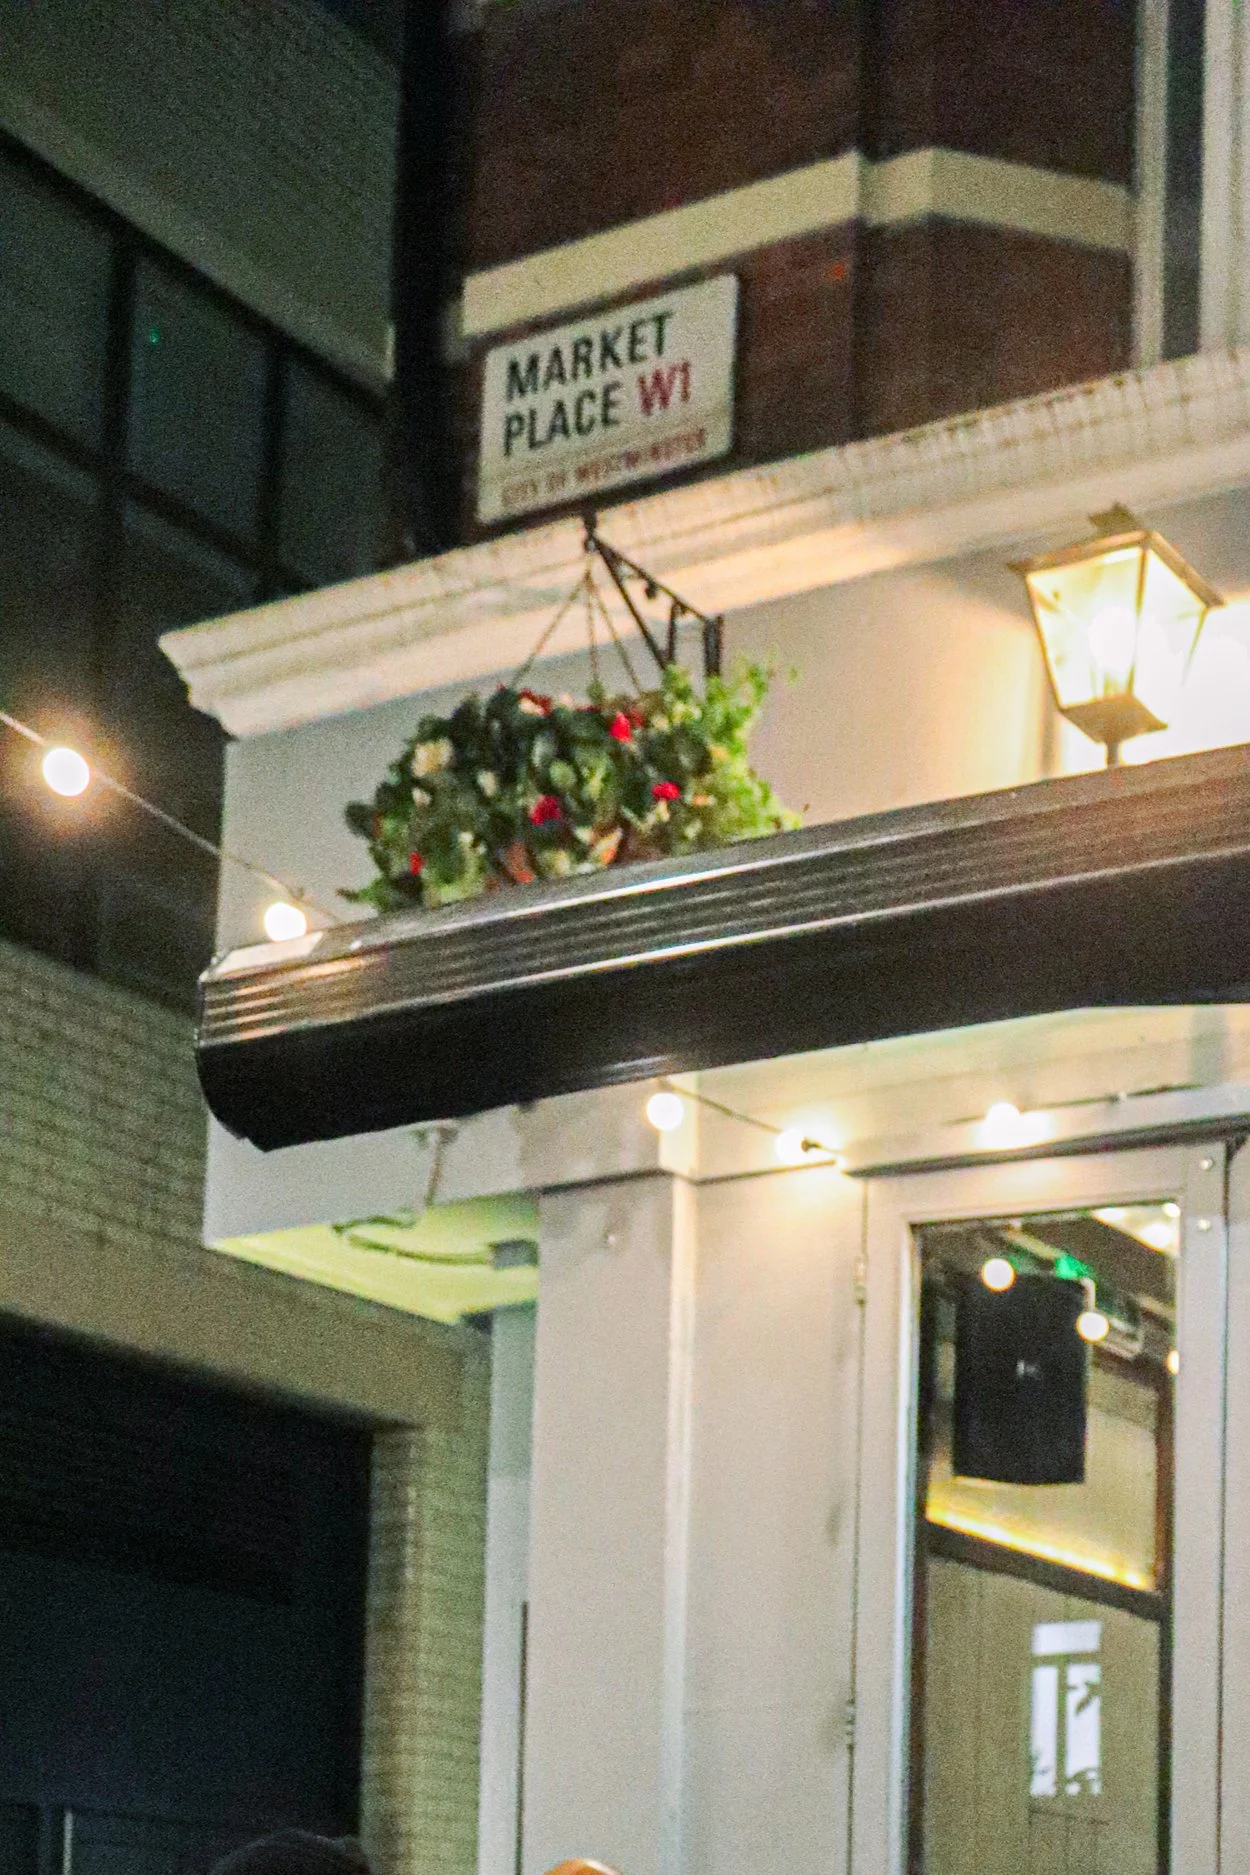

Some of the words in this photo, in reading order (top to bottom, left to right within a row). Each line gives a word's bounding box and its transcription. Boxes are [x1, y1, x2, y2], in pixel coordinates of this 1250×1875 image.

[506, 310, 674, 401] MARKET
[504, 381, 622, 457] PLACE
[637, 358, 691, 417] W1
